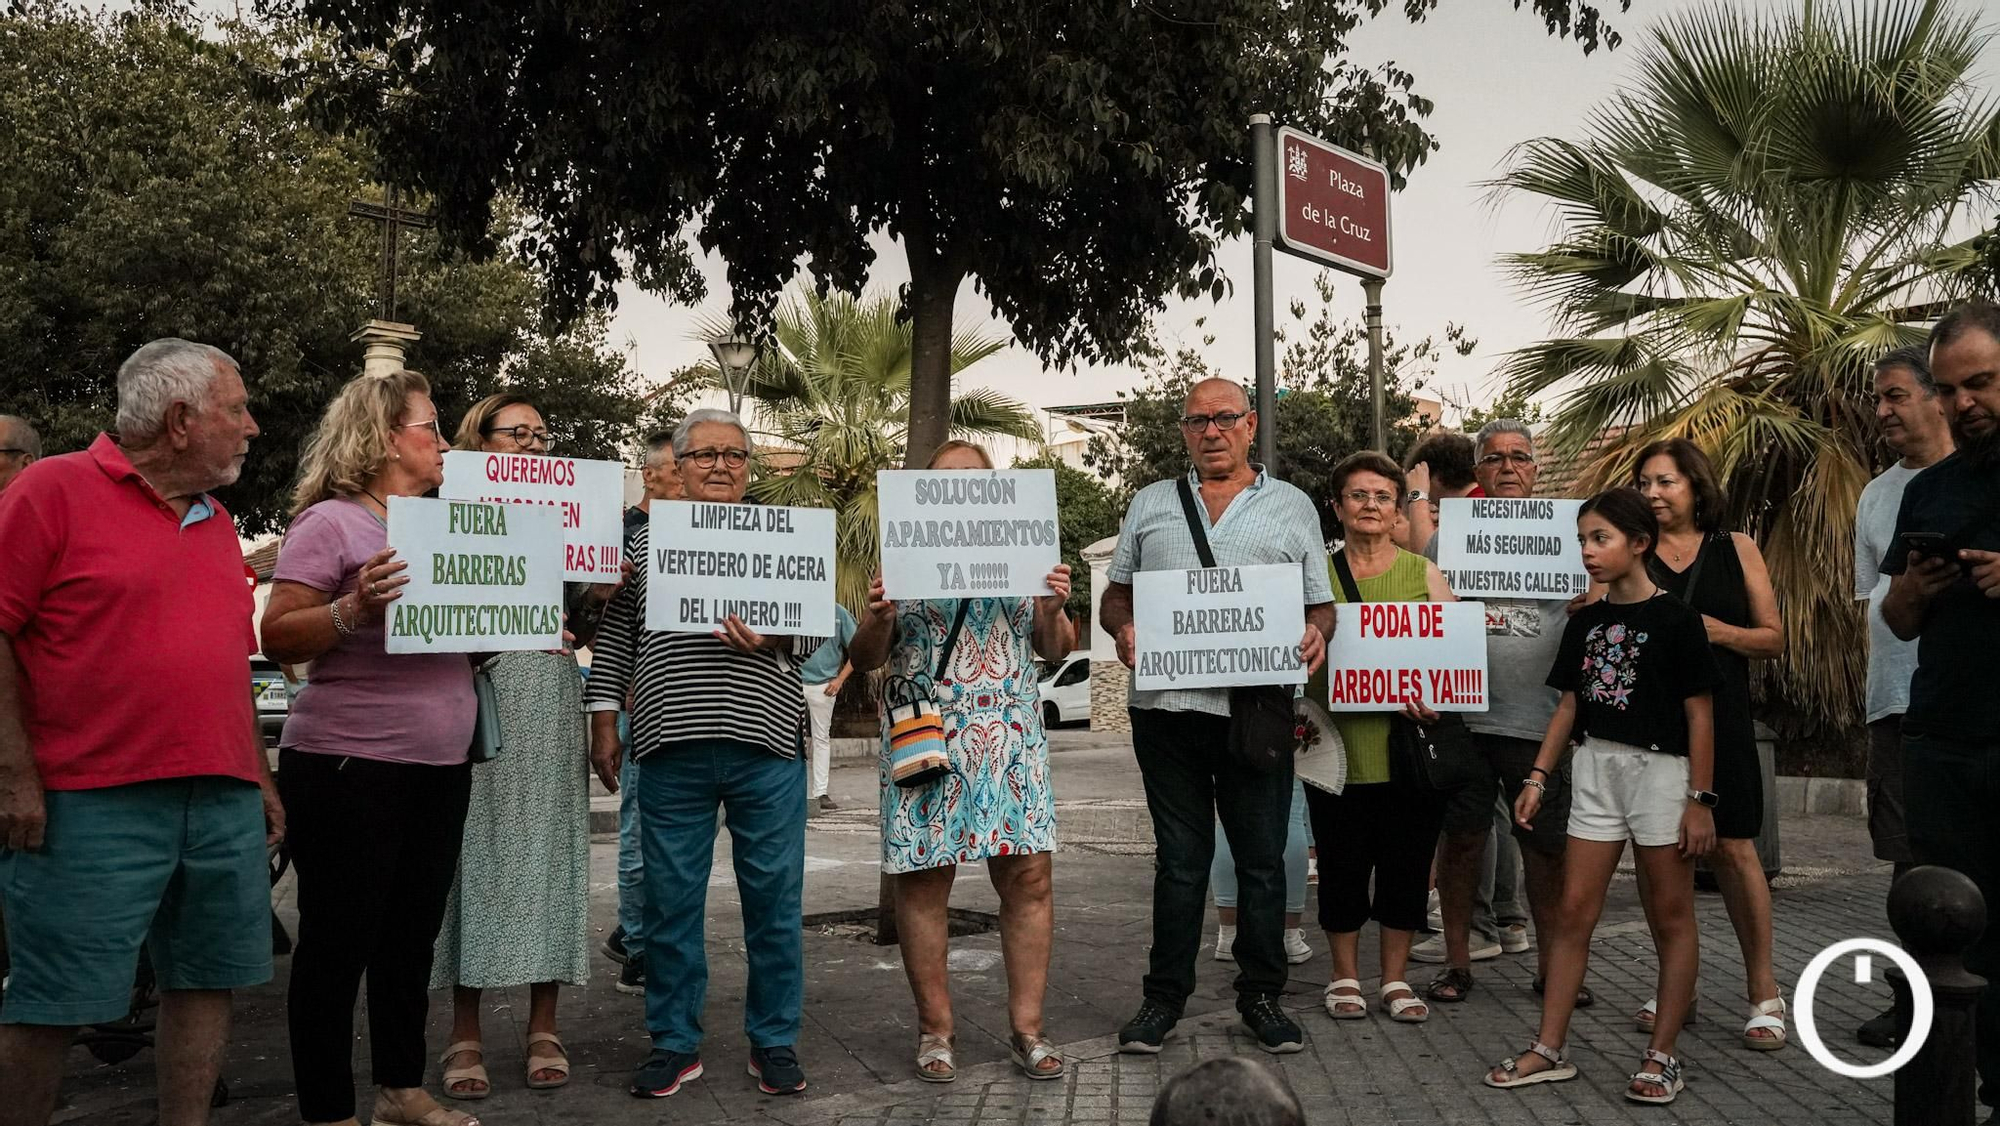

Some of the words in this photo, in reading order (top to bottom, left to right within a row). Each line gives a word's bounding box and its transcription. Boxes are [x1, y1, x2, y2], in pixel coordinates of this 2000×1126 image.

[1329, 169, 1364, 199] Plaza
[1302, 202, 1320, 223] de
[1324, 208, 1336, 229] la
[1340, 216, 1371, 242] Cruz
[486, 454, 575, 486] QUEREMOS
[915, 471, 1016, 505] SOLUCIÓN
[449, 502, 507, 536] FUERA
[691, 503, 761, 532] LIMPIEZA
[766, 508, 794, 533] DEL
[1472, 499, 1553, 520] NECESITAMOS
[884, 519, 1056, 548] APARCAMIENTOS
[1466, 530, 1491, 554] MÁS
[1494, 534, 1561, 556] SEGURIDAD
[432, 553, 526, 586] BARRERAS
[566, 544, 595, 572] RAS
[600, 545, 618, 573] !!!!
[657, 548, 748, 578] VERTEDERO
[752, 553, 772, 579] DE
[776, 555, 826, 581] ACERA
[937, 562, 966, 590] YA
[1186, 567, 1244, 595] FUERA
[1459, 570, 1520, 592] NUESTRAS
[1525, 572, 1569, 593] CALLES
[1572, 573, 1586, 594] !!!!
[391, 604, 559, 644] ARQUITECTONICAS
[680, 597, 708, 624] DEL
[713, 599, 780, 627] LINDERO
[784, 602, 802, 628] !!!!
[1172, 606, 1265, 636] BARRERAS
[1360, 604, 1413, 639] PODA
[1418, 604, 1444, 638] DE
[1138, 645, 1302, 682] ARQUITECTONICAS
[1332, 668, 1423, 704] ARBOLES
[1428, 669, 1483, 704] YA!!!!!
